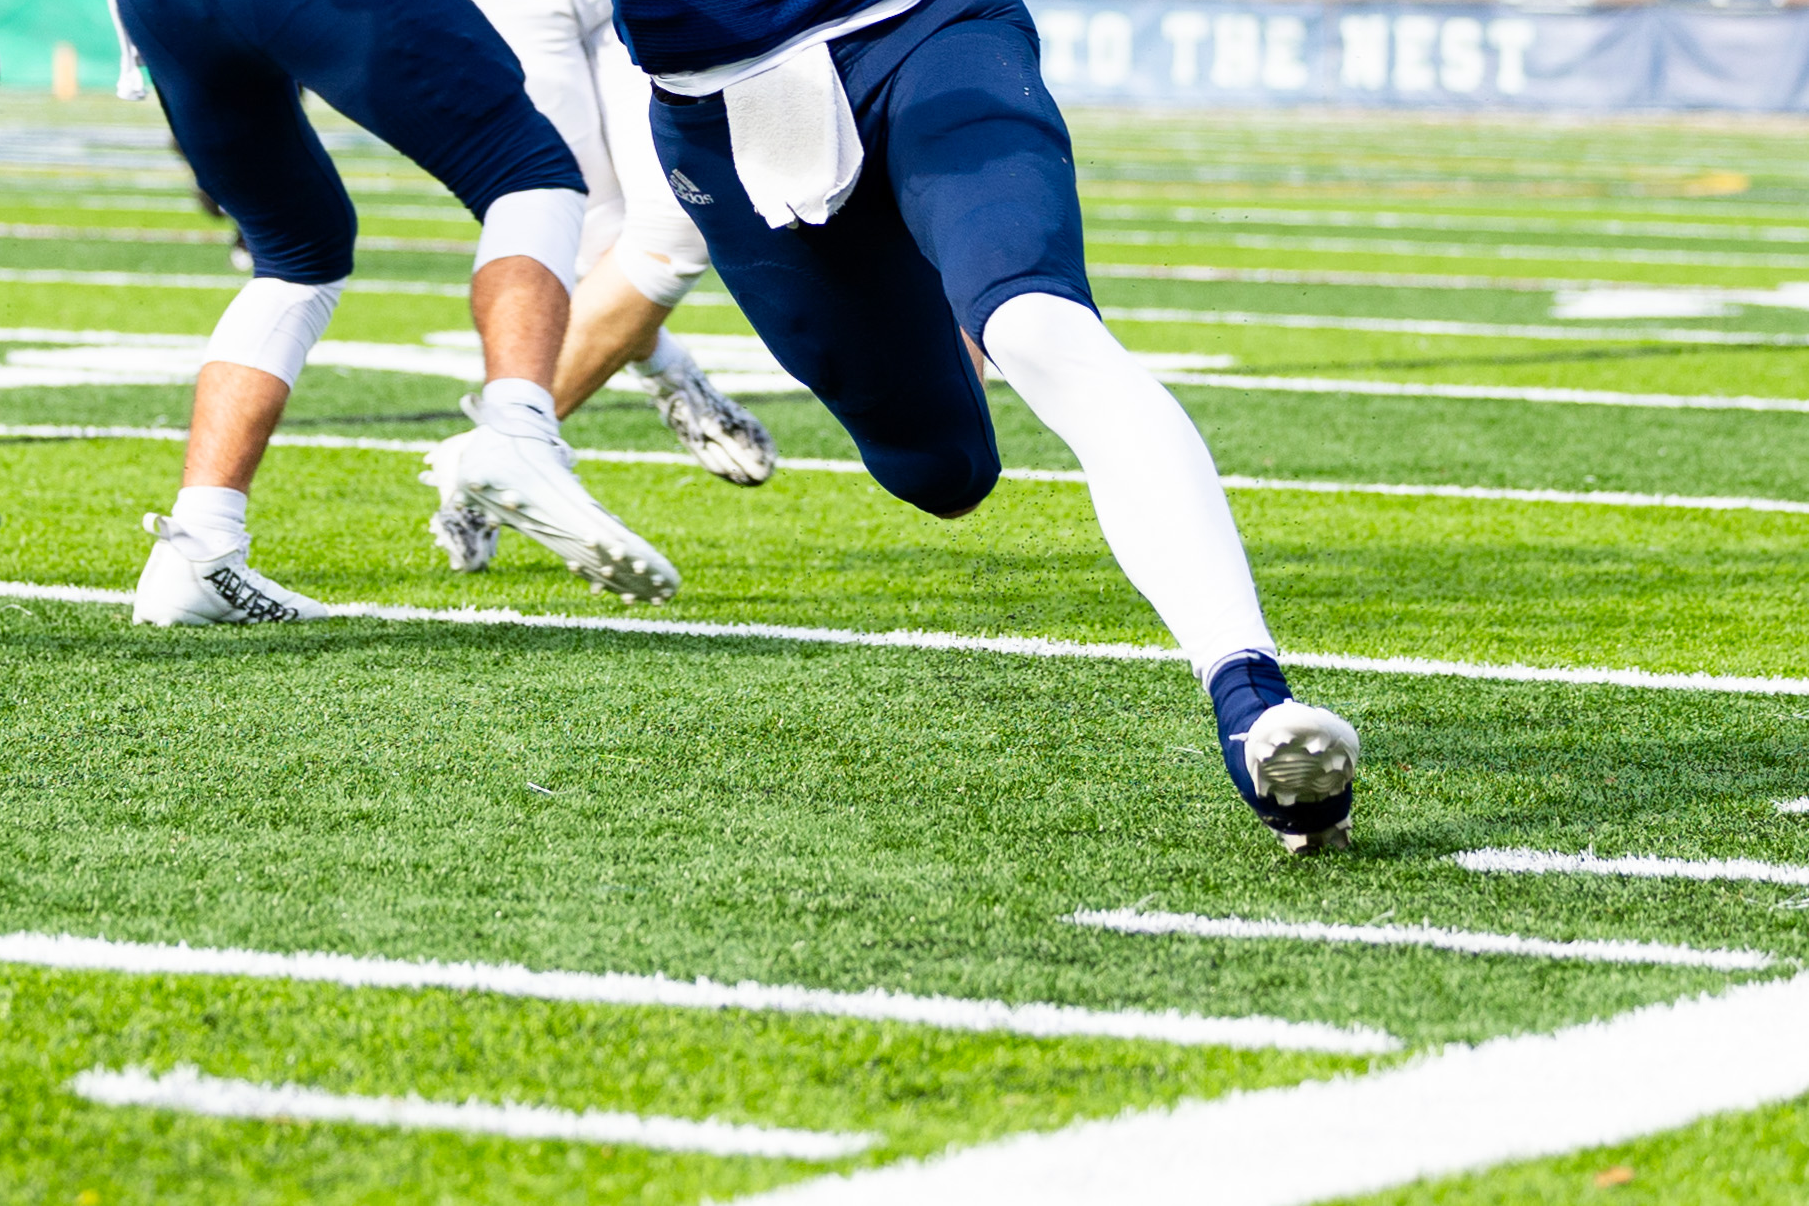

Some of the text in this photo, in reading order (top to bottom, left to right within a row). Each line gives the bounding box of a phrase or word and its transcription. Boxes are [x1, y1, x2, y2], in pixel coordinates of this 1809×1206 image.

[1037, 9, 1537, 94] TO THE NEST
